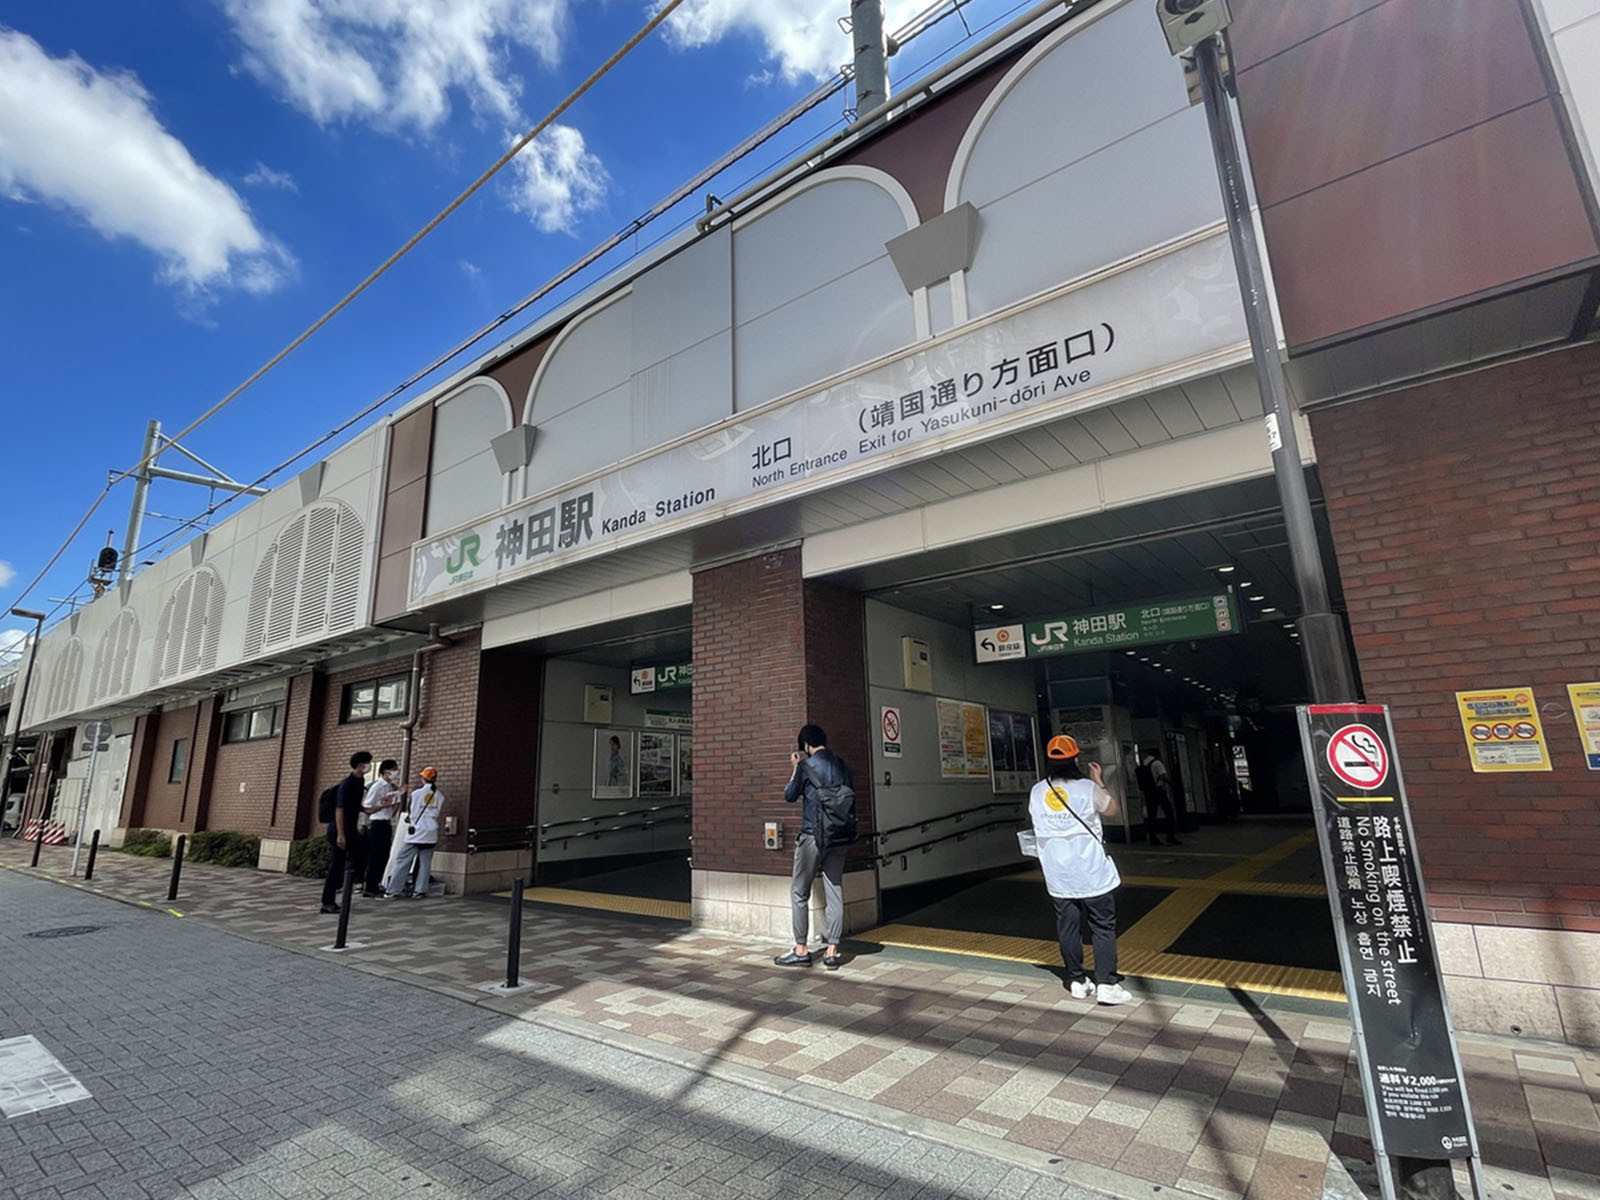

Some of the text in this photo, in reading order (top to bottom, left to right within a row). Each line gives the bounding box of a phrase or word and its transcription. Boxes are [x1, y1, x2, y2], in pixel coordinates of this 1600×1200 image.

[859, 367, 1092, 454] Exit for Yasukuni-dōri Ave
[751, 436, 793, 471] 北口
[752, 448, 848, 488] North Entrance
[495, 492, 594, 570] 神田駅
[601, 487, 716, 535] Kanda Station
[446, 533, 482, 574] JR
[1072, 612, 1127, 635] 神田駅
[1140, 607, 1161, 619] 北口
[1031, 621, 1068, 646] JR
[1073, 636, 1104, 648] Kanda
[1105, 631, 1140, 645] Station
[658, 666, 677, 682] JR
[1336, 816, 1362, 891] 道路禁止吸烟
[1372, 816, 1418, 965] 路上喫煙禁止
[1356, 816, 1402, 1006] No Smoking on the street
[1351, 897, 1381, 998] 노상 흡연 금지
[1401, 1075, 1437, 1087] ¥2,000
